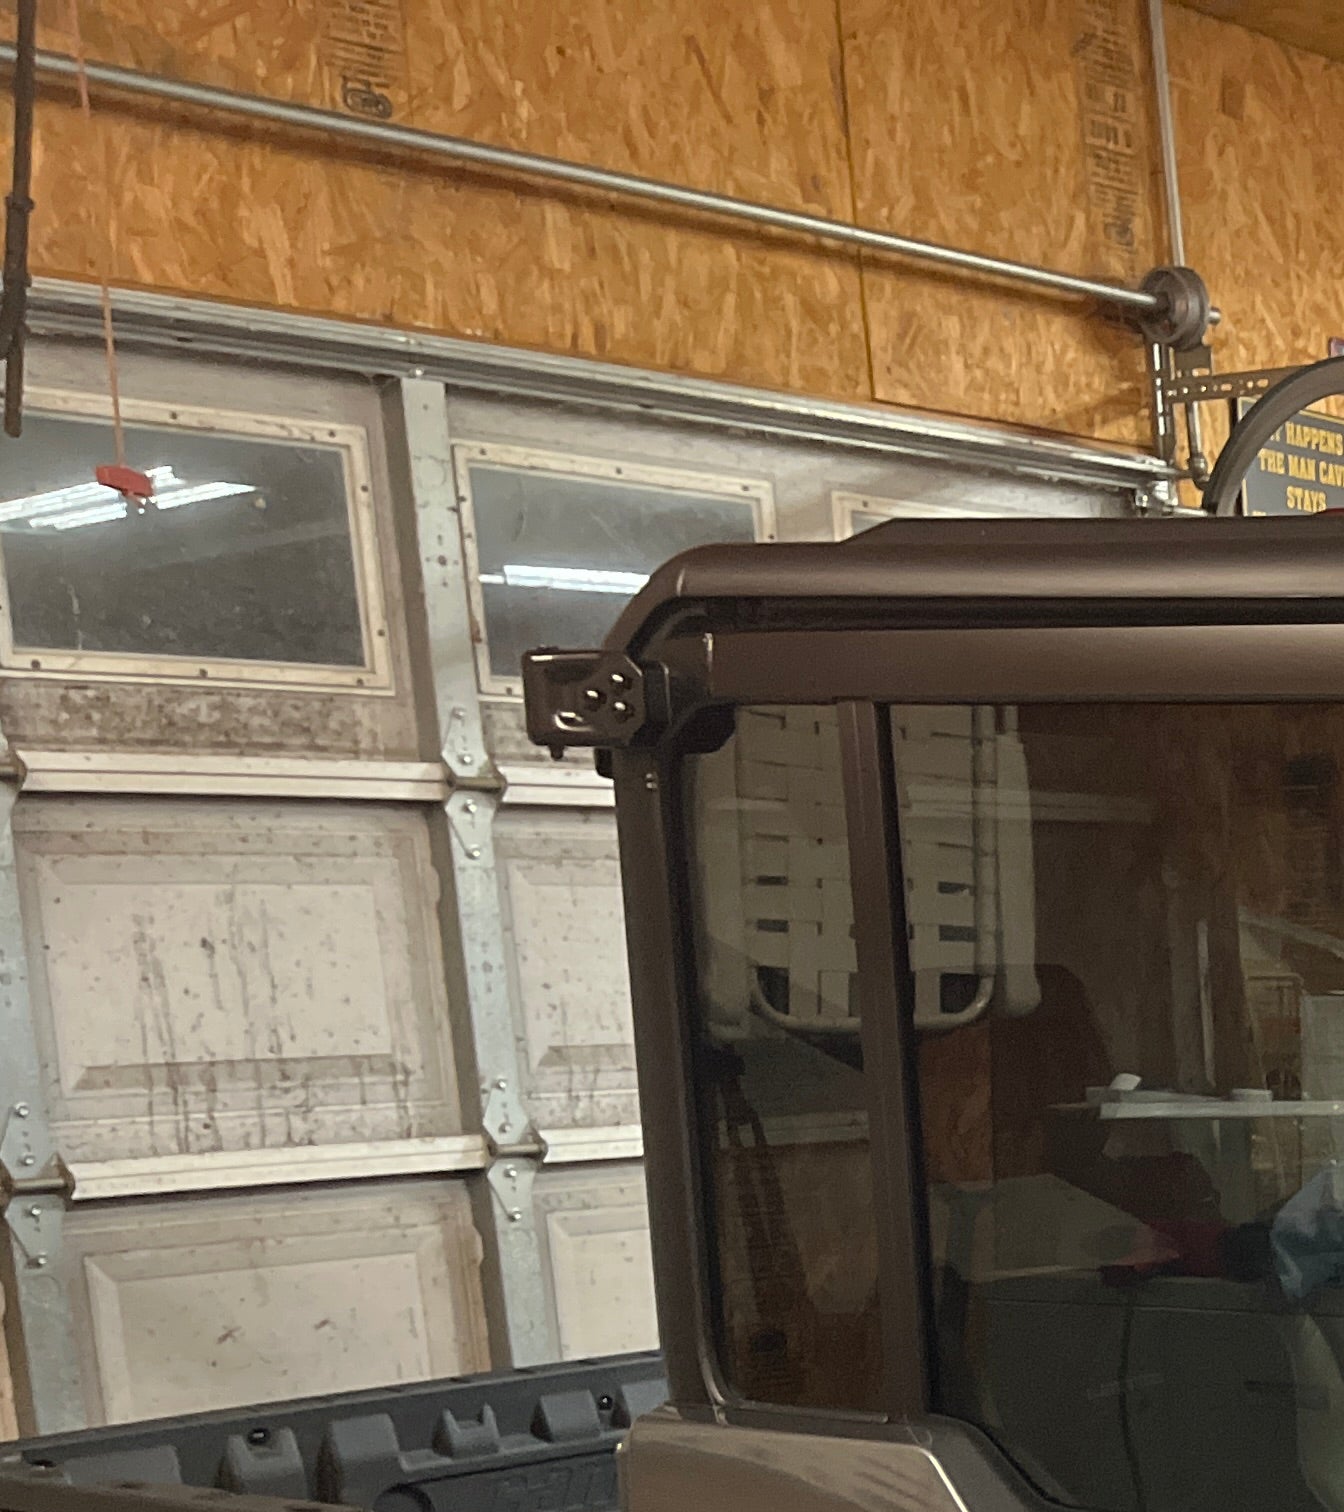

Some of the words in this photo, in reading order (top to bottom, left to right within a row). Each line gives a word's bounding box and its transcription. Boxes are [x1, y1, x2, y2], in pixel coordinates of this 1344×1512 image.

[1286, 421, 1343, 455] HAPPENS
[1258, 448, 1285, 474] THE
[1288, 454, 1316, 481] MAN
[1287, 486, 1326, 513] STAYS
